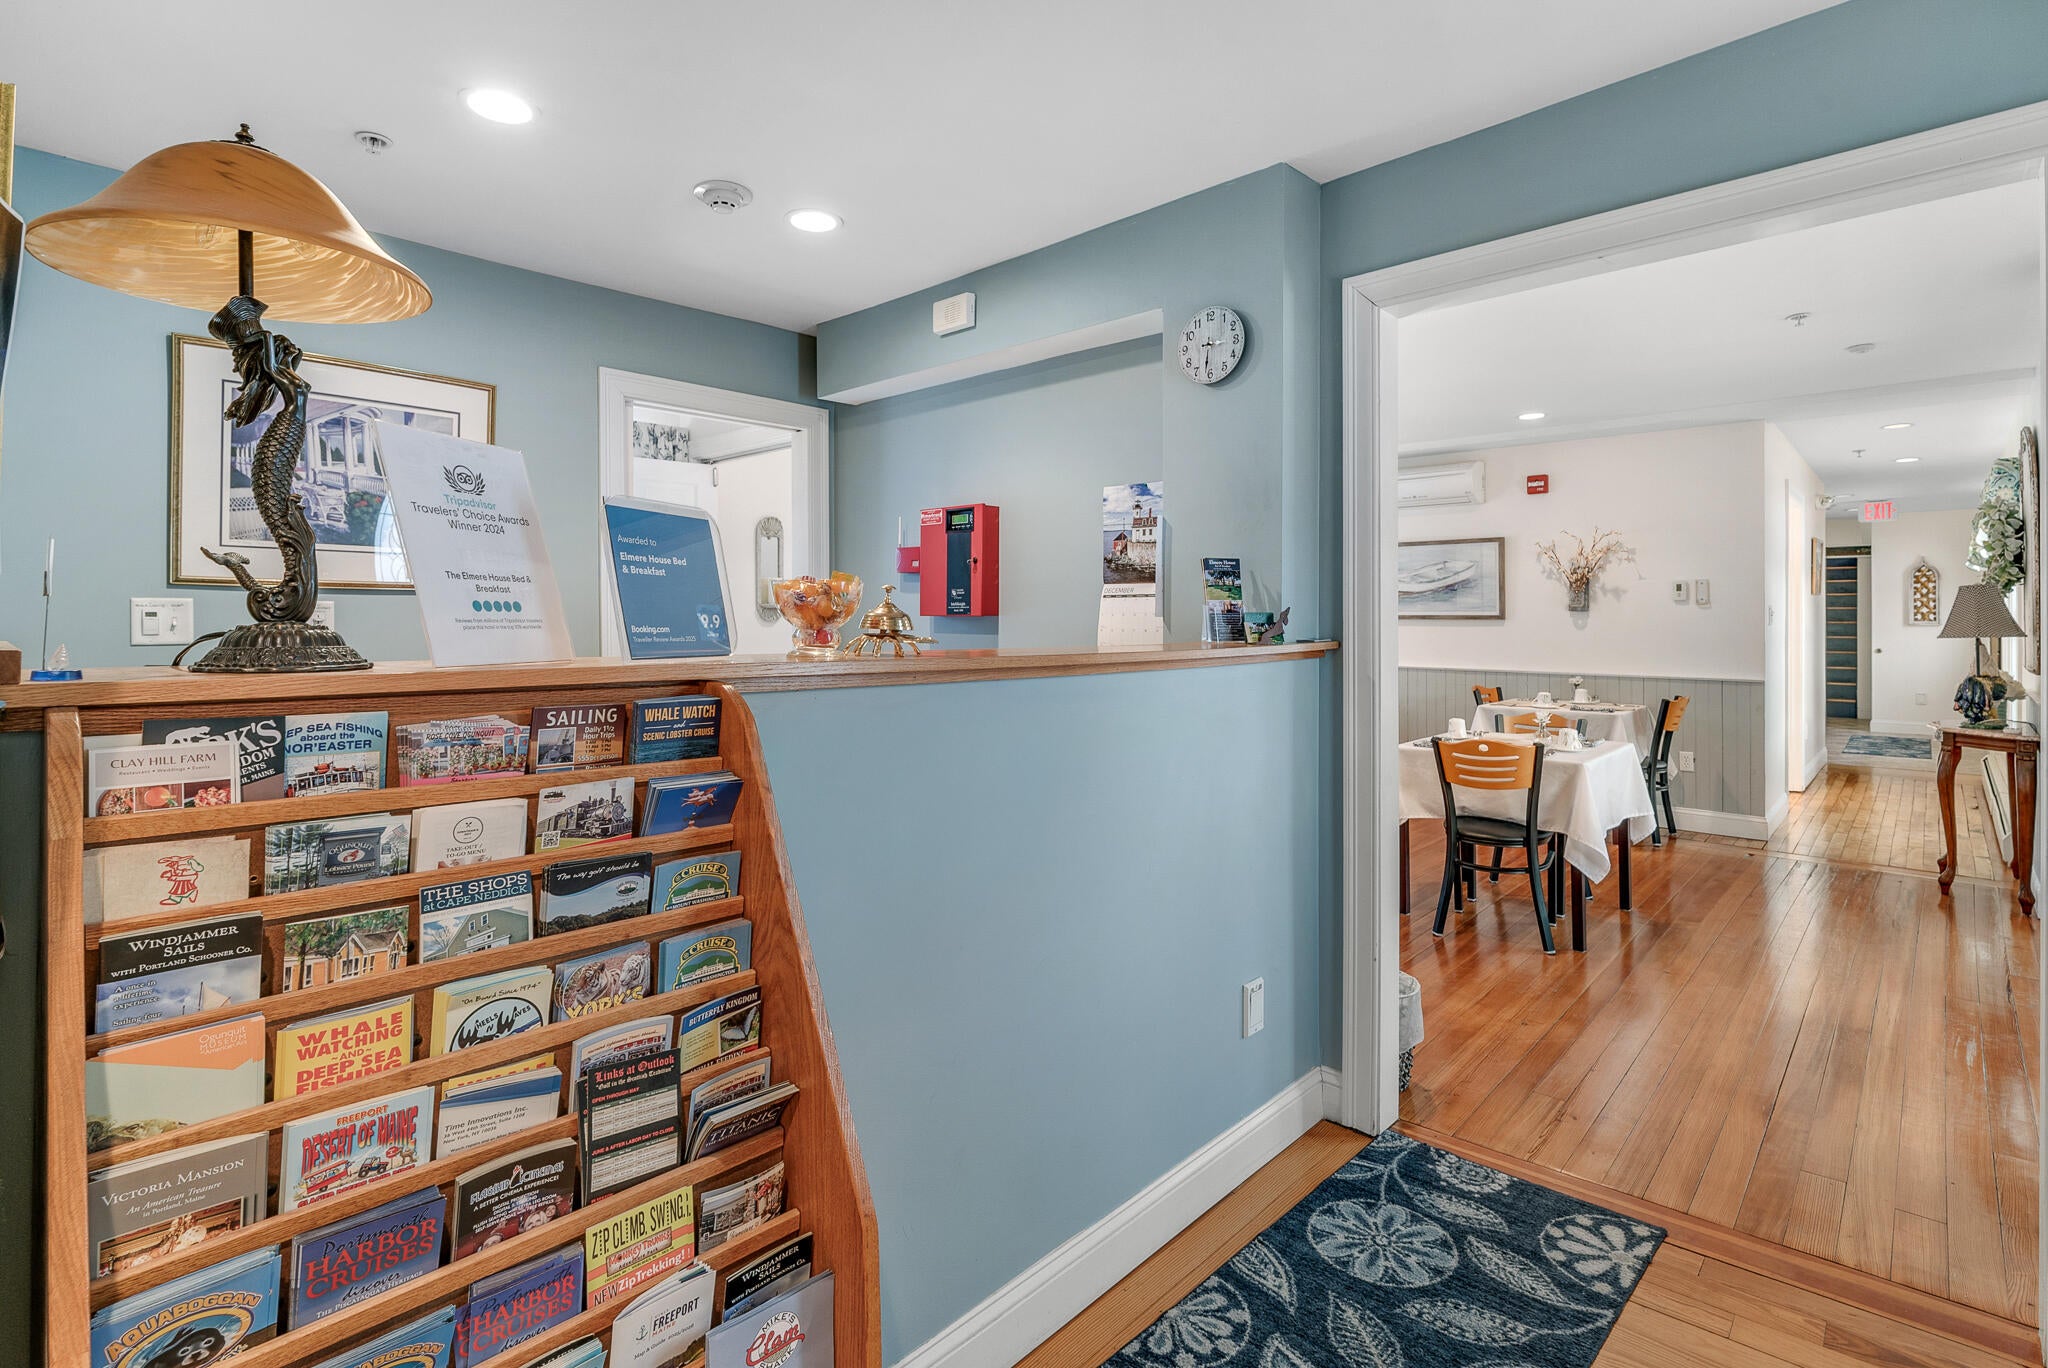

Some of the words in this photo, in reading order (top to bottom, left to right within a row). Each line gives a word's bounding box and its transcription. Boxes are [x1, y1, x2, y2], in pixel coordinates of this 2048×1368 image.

[1193, 318, 1201, 330] 11
[1206, 310, 1216, 323] 12
[1222, 312, 1227, 324] 1
[1229, 320, 1237, 332] 2
[1185, 330, 1195, 342] 10
[1232, 333, 1240, 345] 3
[1181, 345, 1189, 356] 9
[1229, 348, 1237, 360] 4
[1185, 358, 1192, 369] 8
[1193, 366, 1200, 377] 7
[1221, 361, 1228, 372] 5
[1206, 368, 1214, 379] 6
[443, 493, 497, 510] Tripadvisor
[410, 501, 461, 518] Travelers'
[462, 508, 496, 523] Choice
[498, 513, 530, 527] Awards
[1864, 501, 1893, 521] EXIT
[447, 519, 482, 533] Winner
[483, 523, 505, 535] 2024
[617, 534, 649, 546] Awarded
[649, 539, 657, 547] to
[619, 551, 648, 563] Elmere
[648, 554, 672, 565] House
[672, 556, 687, 566] Bed
[445, 570, 461, 580] The
[461, 571, 488, 582] Elmere
[488, 573, 511, 583] House
[512, 574, 525, 583] Bed
[526, 575, 532, 583] &
[622, 564, 630, 574] &
[630, 565, 667, 577] Breakfast
[475, 583, 512, 594] Breakfast
[631, 625, 671, 635] Booking.com
[700, 613, 721, 629] 9.9
[545, 707, 618, 727] SAILING
[644, 706, 681, 722] WHALE
[682, 704, 717, 719] WATCH
[300, 732, 337, 742] aboard
[339, 731, 356, 740] the
[306, 722, 332, 733] SEA
[335, 722, 384, 738] FISHING
[444, 731, 461, 739] COVE
[582, 732, 599, 740] Hour
[600, 731, 616, 740] Trips
[584, 725, 602, 733] Daily
[642, 731, 666, 741] SCENIC
[666, 729, 693, 739] LOBSTER
[693, 727, 715, 737] CRUISE
[285, 739, 373, 754] NOR'EASTER
[110, 758, 145, 769] CLAY
[149, 755, 177, 767] HILL
[180, 752, 217, 765] FARM
[250, 768, 276, 780] MAINE
[445, 850, 467, 859] TO-GO
[466, 848, 487, 857] MENU
[446, 843, 478, 853] TAKE-OUT
[556, 873, 572, 881] The
[572, 871, 588, 879] way
[588, 866, 606, 878] golf
[605, 862, 631, 873] should
[631, 860, 640, 868] be
[681, 863, 720, 877] CRUISE
[423, 884, 464, 903] THE
[467, 873, 528, 895] SHOPS
[423, 902, 435, 912] at
[436, 895, 472, 909] CAPE
[474, 884, 528, 902] NEDDICK
[672, 901, 692, 910] MOUNT
[692, 893, 727, 905] WASHINGTON
[128, 925, 240, 952] WINDJAMMER
[689, 937, 727, 952] CRUISE
[163, 942, 206, 957] SAILS
[138, 957, 187, 973] PORTLAND
[188, 949, 234, 963] SCHOONER
[115, 985, 123, 993] A
[125, 983, 146, 992] once
[147, 980, 157, 988] in
[121, 989, 154, 1001] lifetime
[475, 992, 497, 1003] Board
[498, 988, 518, 997] Since
[688, 1000, 726, 1027] BUTTERFLY
[725, 991, 758, 1010] KINGDOM
[112, 1015, 142, 1028] Sailing
[297, 1011, 403, 1047] WHALE
[199, 1025, 248, 1043] Ogunquit
[200, 1033, 247, 1051] MUSEUM
[296, 1024, 403, 1061] WATCHING
[296, 1059, 355, 1085] DEEP
[361, 1046, 402, 1068] SEA
[594, 1068, 624, 1083] Links
[626, 1064, 635, 1075] at
[637, 1054, 675, 1072] Outlook
[591, 1095, 606, 1104] OPEN
[606, 1090, 629, 1100] THROUGH
[629, 1086, 641, 1095] MAY
[336, 1104, 389, 1126] FREEPORT
[445, 1122, 466, 1133] Time
[467, 1110, 513, 1126] Innovations
[514, 1105, 528, 1113] Inc.
[710, 1105, 781, 1141] TITANIC
[301, 1123, 357, 1178] DESERT
[357, 1119, 377, 1150] OF
[377, 1105, 419, 1149] MAINE
[443, 1136, 456, 1145] New
[451, 1128, 466, 1137] West
[591, 1148, 606, 1156] JUNE
[609, 1141, 626, 1151] AFTER
[626, 1136, 642, 1146] LABOR
[659, 1126, 675, 1135] CLOSE
[101, 1180, 172, 1207] VICTORIA
[177, 1158, 246, 1186] MANSION
[126, 1205, 140, 1216] An
[142, 1192, 186, 1211] American
[188, 1181, 223, 1195] Treasure
[469, 1178, 511, 1206] FLAGSHIP
[473, 1205, 479, 1213] A
[479, 1196, 500, 1210] BETTER
[500, 1187, 524, 1200] CINEMA
[523, 1174, 560, 1192] EXPERIENCE!
[151, 1201, 184, 1216] Portland,
[184, 1194, 206, 1205] Maine
[322, 1207, 431, 1259] Portsmouth
[591, 1226, 610, 1260] ZIP.
[612, 1210, 648, 1249] CLIMB.
[642, 1230, 671, 1249] TRUNKS
[305, 1217, 440, 1282] HARBOR
[305, 1236, 434, 1299] CRUISES
[741, 1245, 800, 1283] WINDJAMMER
[758, 1262, 782, 1281] SAILS
[315, 1309, 333, 1319] THE
[387, 1270, 424, 1288] HERITAGE
[341, 1271, 401, 1302] discover
[480, 1264, 573, 1317] Portsmouth
[744, 1276, 771, 1296] PORTLAND
[471, 1274, 577, 1335] HARBOR
[471, 1292, 575, 1352] CRUISES
[652, 1296, 700, 1332] FREEPORT
[761, 1312, 797, 1333] MIKE'S
[103, 1290, 263, 1363] AQUABOGGAN
[651, 1320, 676, 1337] MAINE
[500, 1326, 547, 1352] discover
[745, 1323, 806, 1367] Clam
[634, 1349, 645, 1361] Map
[650, 1338, 666, 1350] Guide
